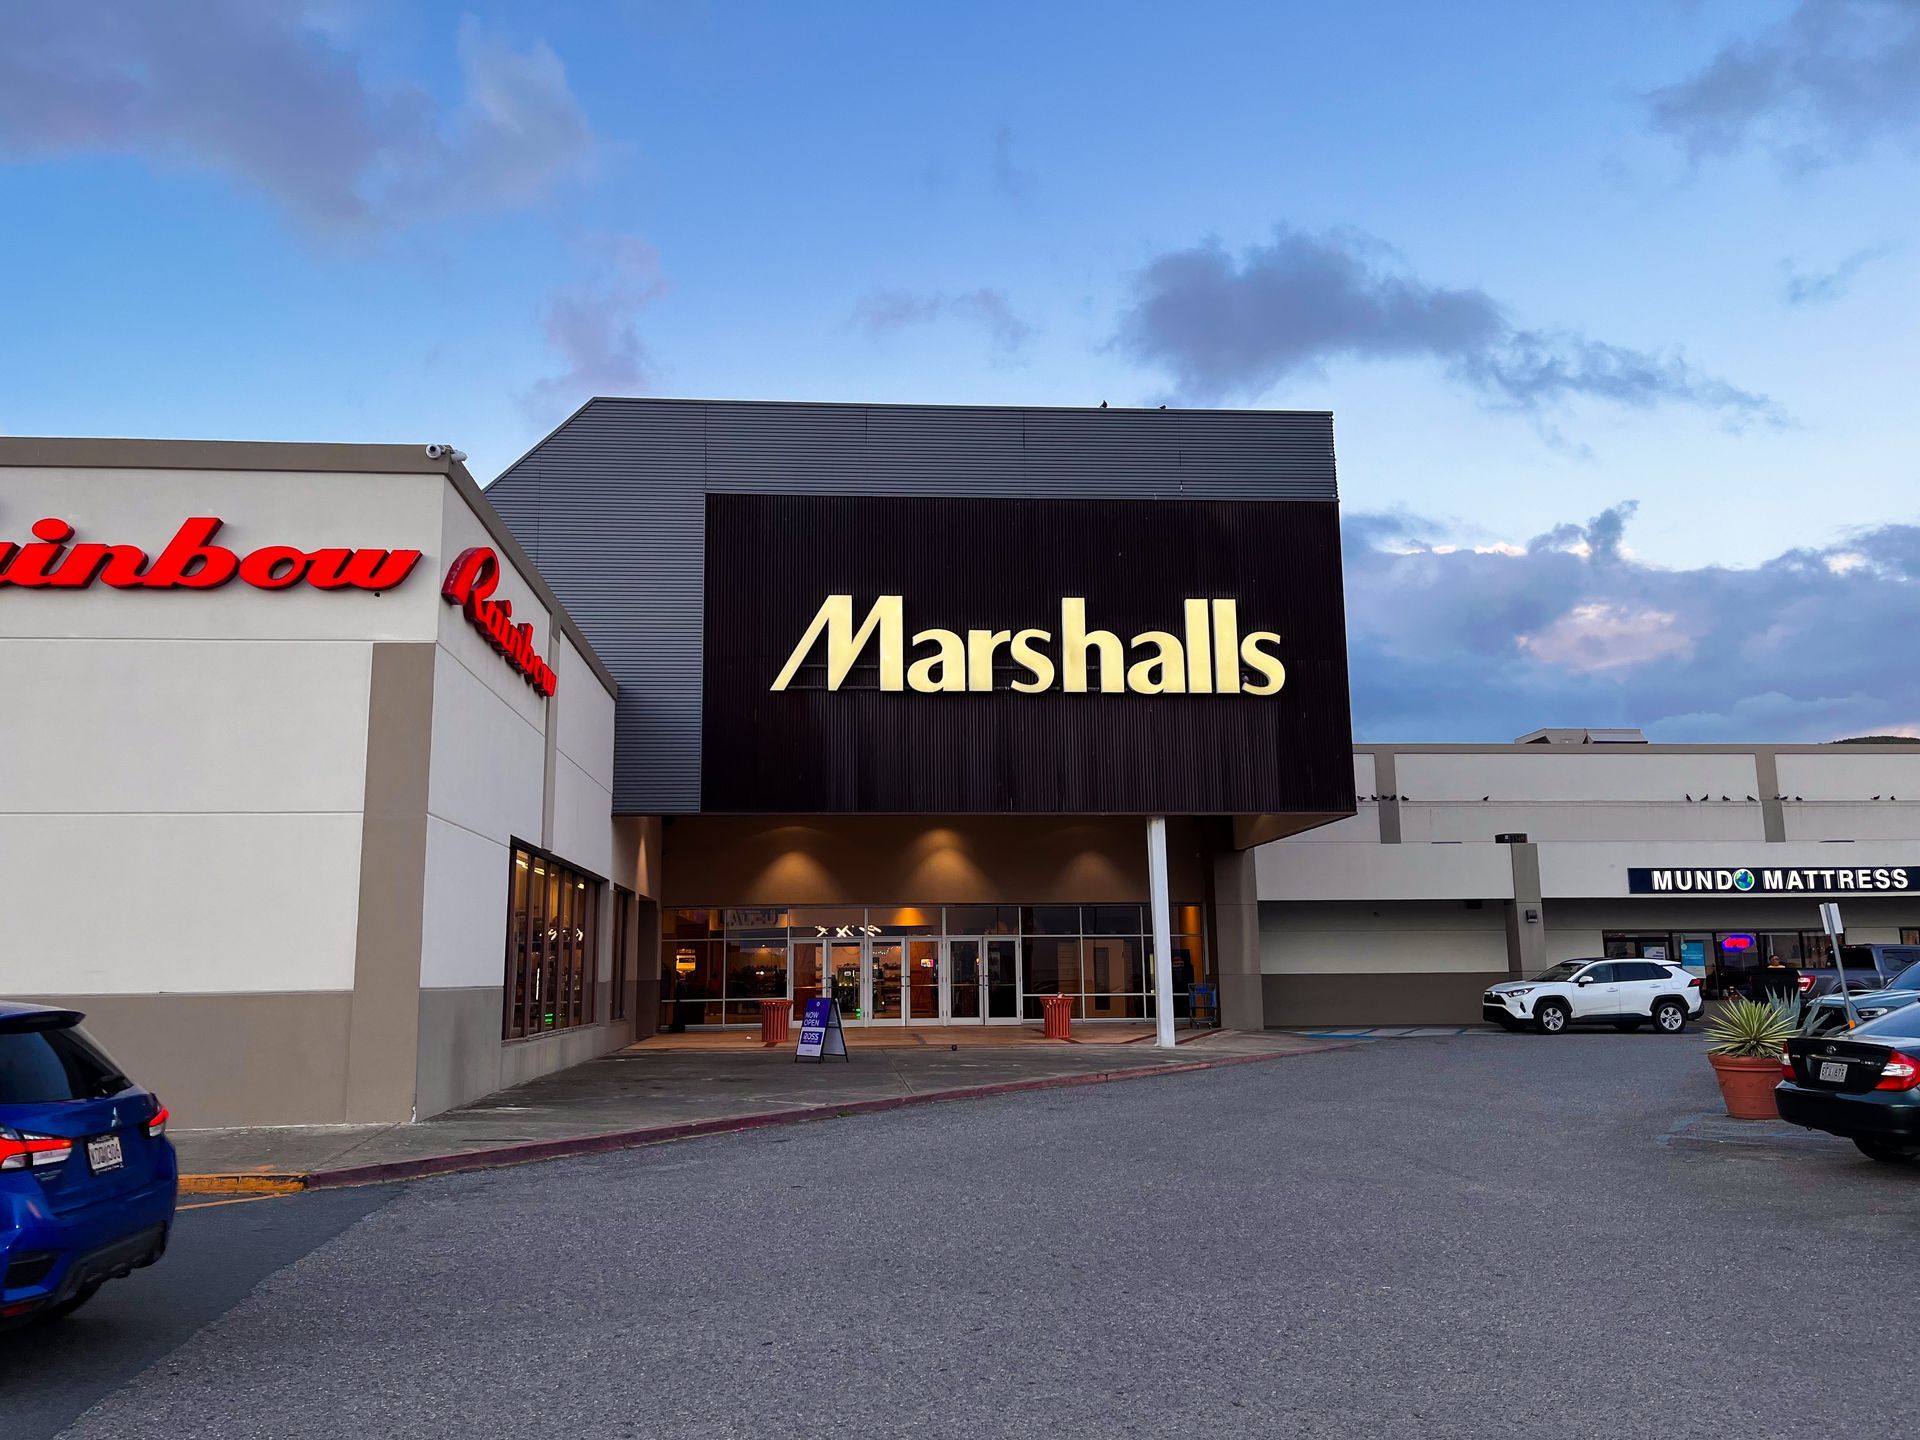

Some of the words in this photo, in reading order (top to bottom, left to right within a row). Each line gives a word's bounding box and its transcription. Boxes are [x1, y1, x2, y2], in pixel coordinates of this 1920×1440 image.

[0, 516, 423, 590] inbow
[440, 547, 557, 698] Rainbow
[769, 594, 1286, 695] Marshalls
[1761, 869, 1909, 889] MATTRESS
[803, 1019, 820, 1027] OPEN
[805, 1011, 820, 1019] NOW
